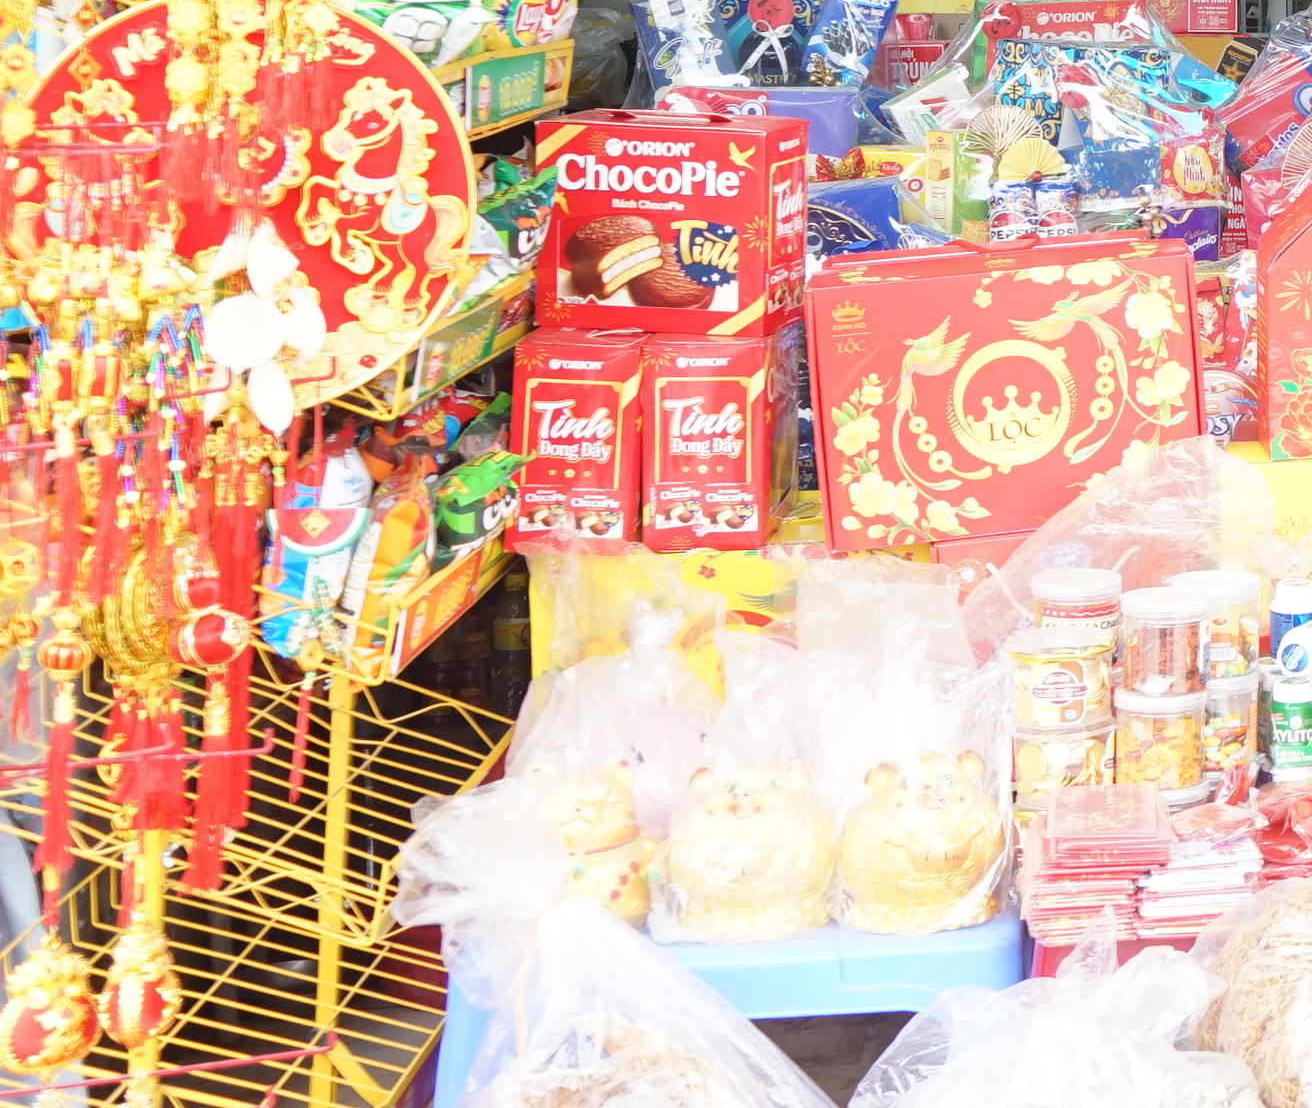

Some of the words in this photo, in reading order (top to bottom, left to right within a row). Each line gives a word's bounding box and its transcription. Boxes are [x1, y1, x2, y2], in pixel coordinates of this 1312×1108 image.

[1052, 12, 1095, 23] ORION
[627, 141, 691, 157] ORION
[556, 153, 741, 198] ChocoPie
[612, 198, 636, 210] Bánh
[638, 199, 685, 212] ChocoPie
[671, 219, 739, 274] Tình
[836, 338, 866, 355] LỘC
[560, 360, 602, 370] ORION
[688, 358, 729, 368] ORION
[533, 399, 615, 438] Tình
[663, 397, 742, 436] Tình
[988, 412, 1044, 445] LỘC
[540, 440, 577, 460] Đong
[581, 439, 612, 462] Đầy
[670, 438, 709, 458] Đong
[711, 436, 741, 459] Đầy
